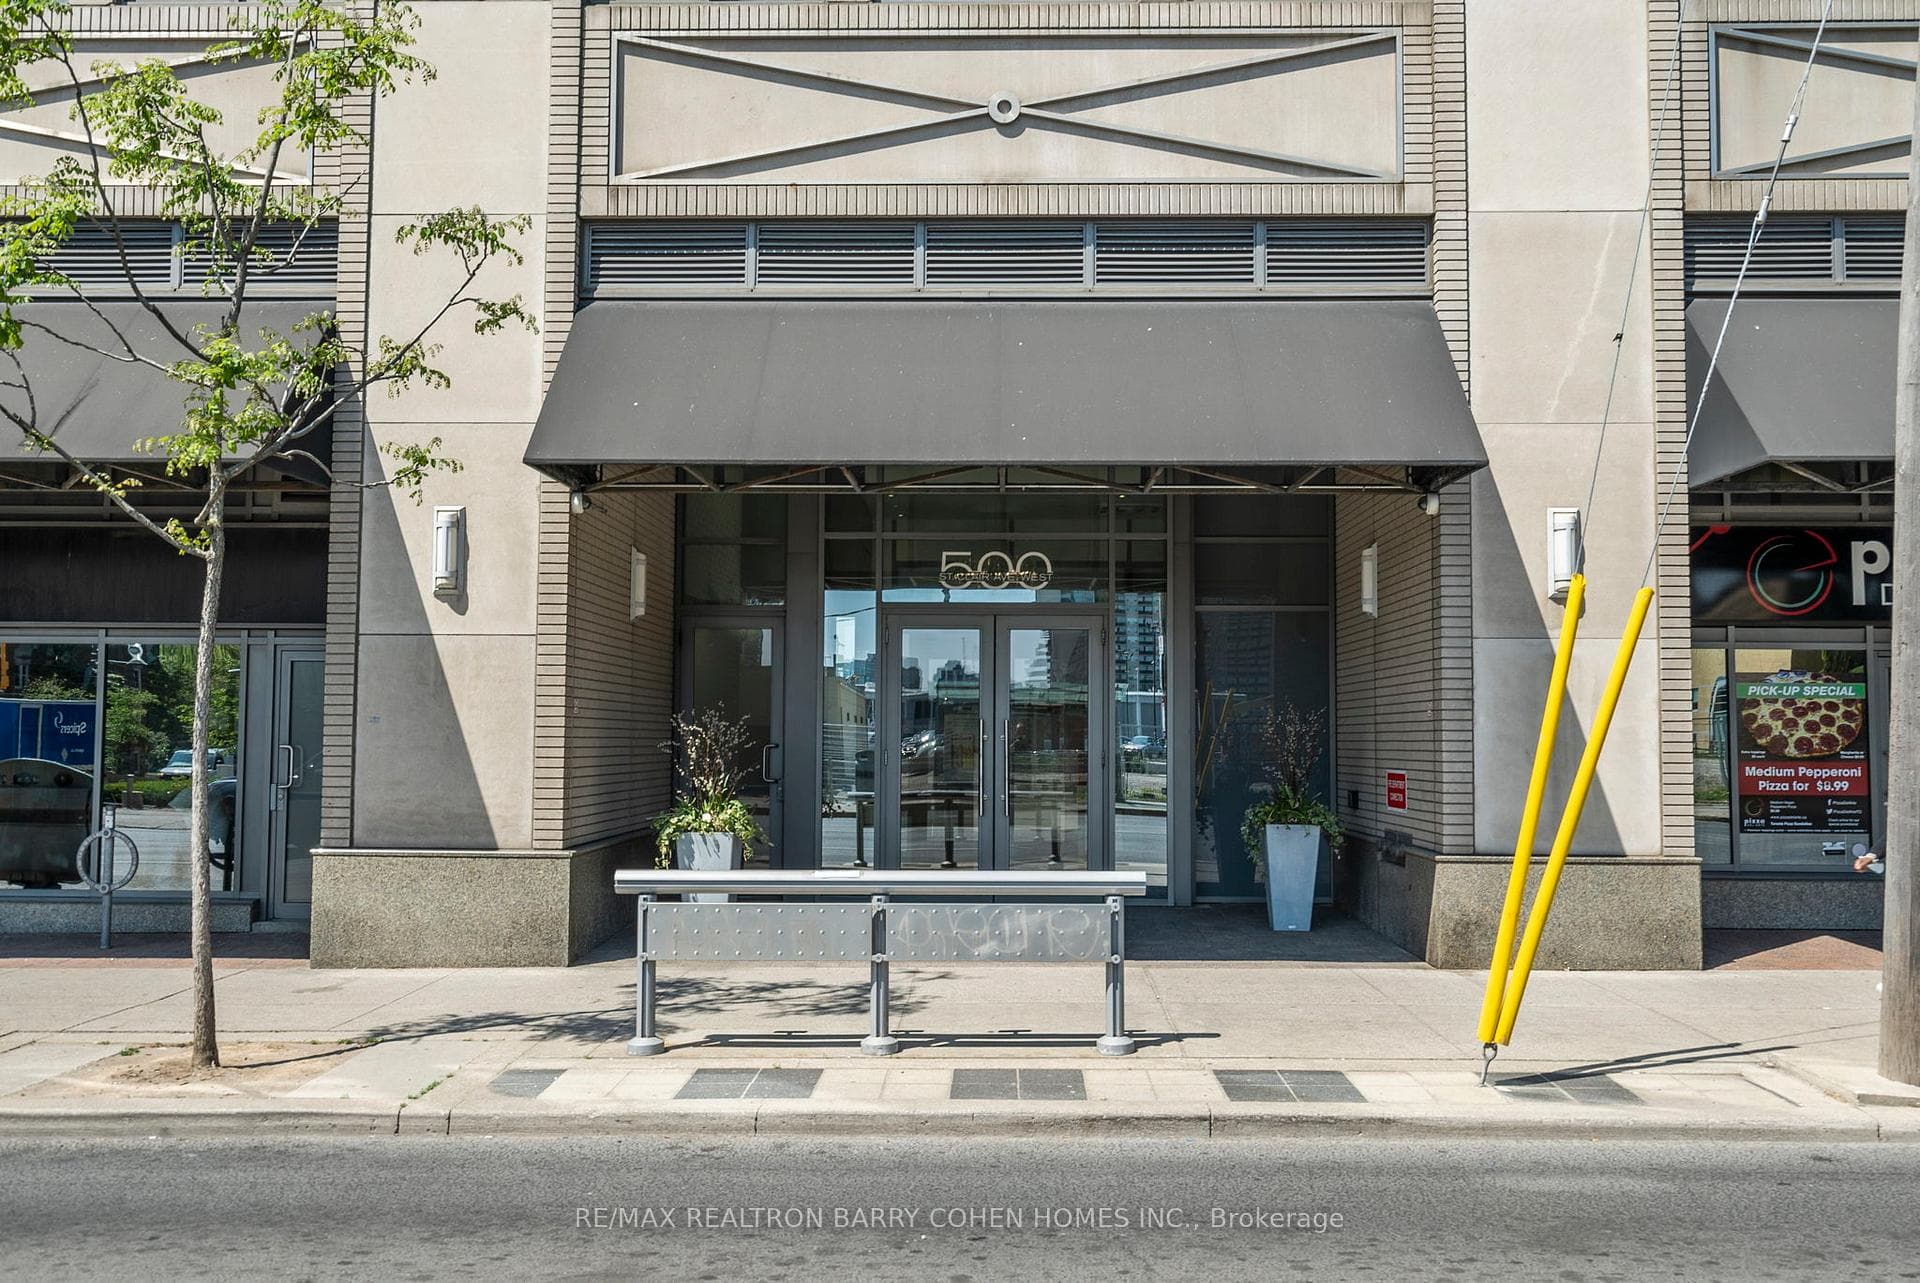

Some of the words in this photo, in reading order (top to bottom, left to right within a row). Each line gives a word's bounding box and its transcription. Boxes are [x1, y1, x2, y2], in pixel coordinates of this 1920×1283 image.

[940, 551, 1052, 589] 500
[1020, 572, 1053, 581] WEST
[1747, 685, 1801, 696] PICK-UP
[1802, 685, 1856, 696] SPECIAL
[1744, 766, 1795, 777] Medium
[1798, 766, 1862, 779] Pepperoni
[1758, 780, 1790, 791] Pizza
[1792, 780, 1810, 791] for
[1816, 780, 1849, 792] $8.99
